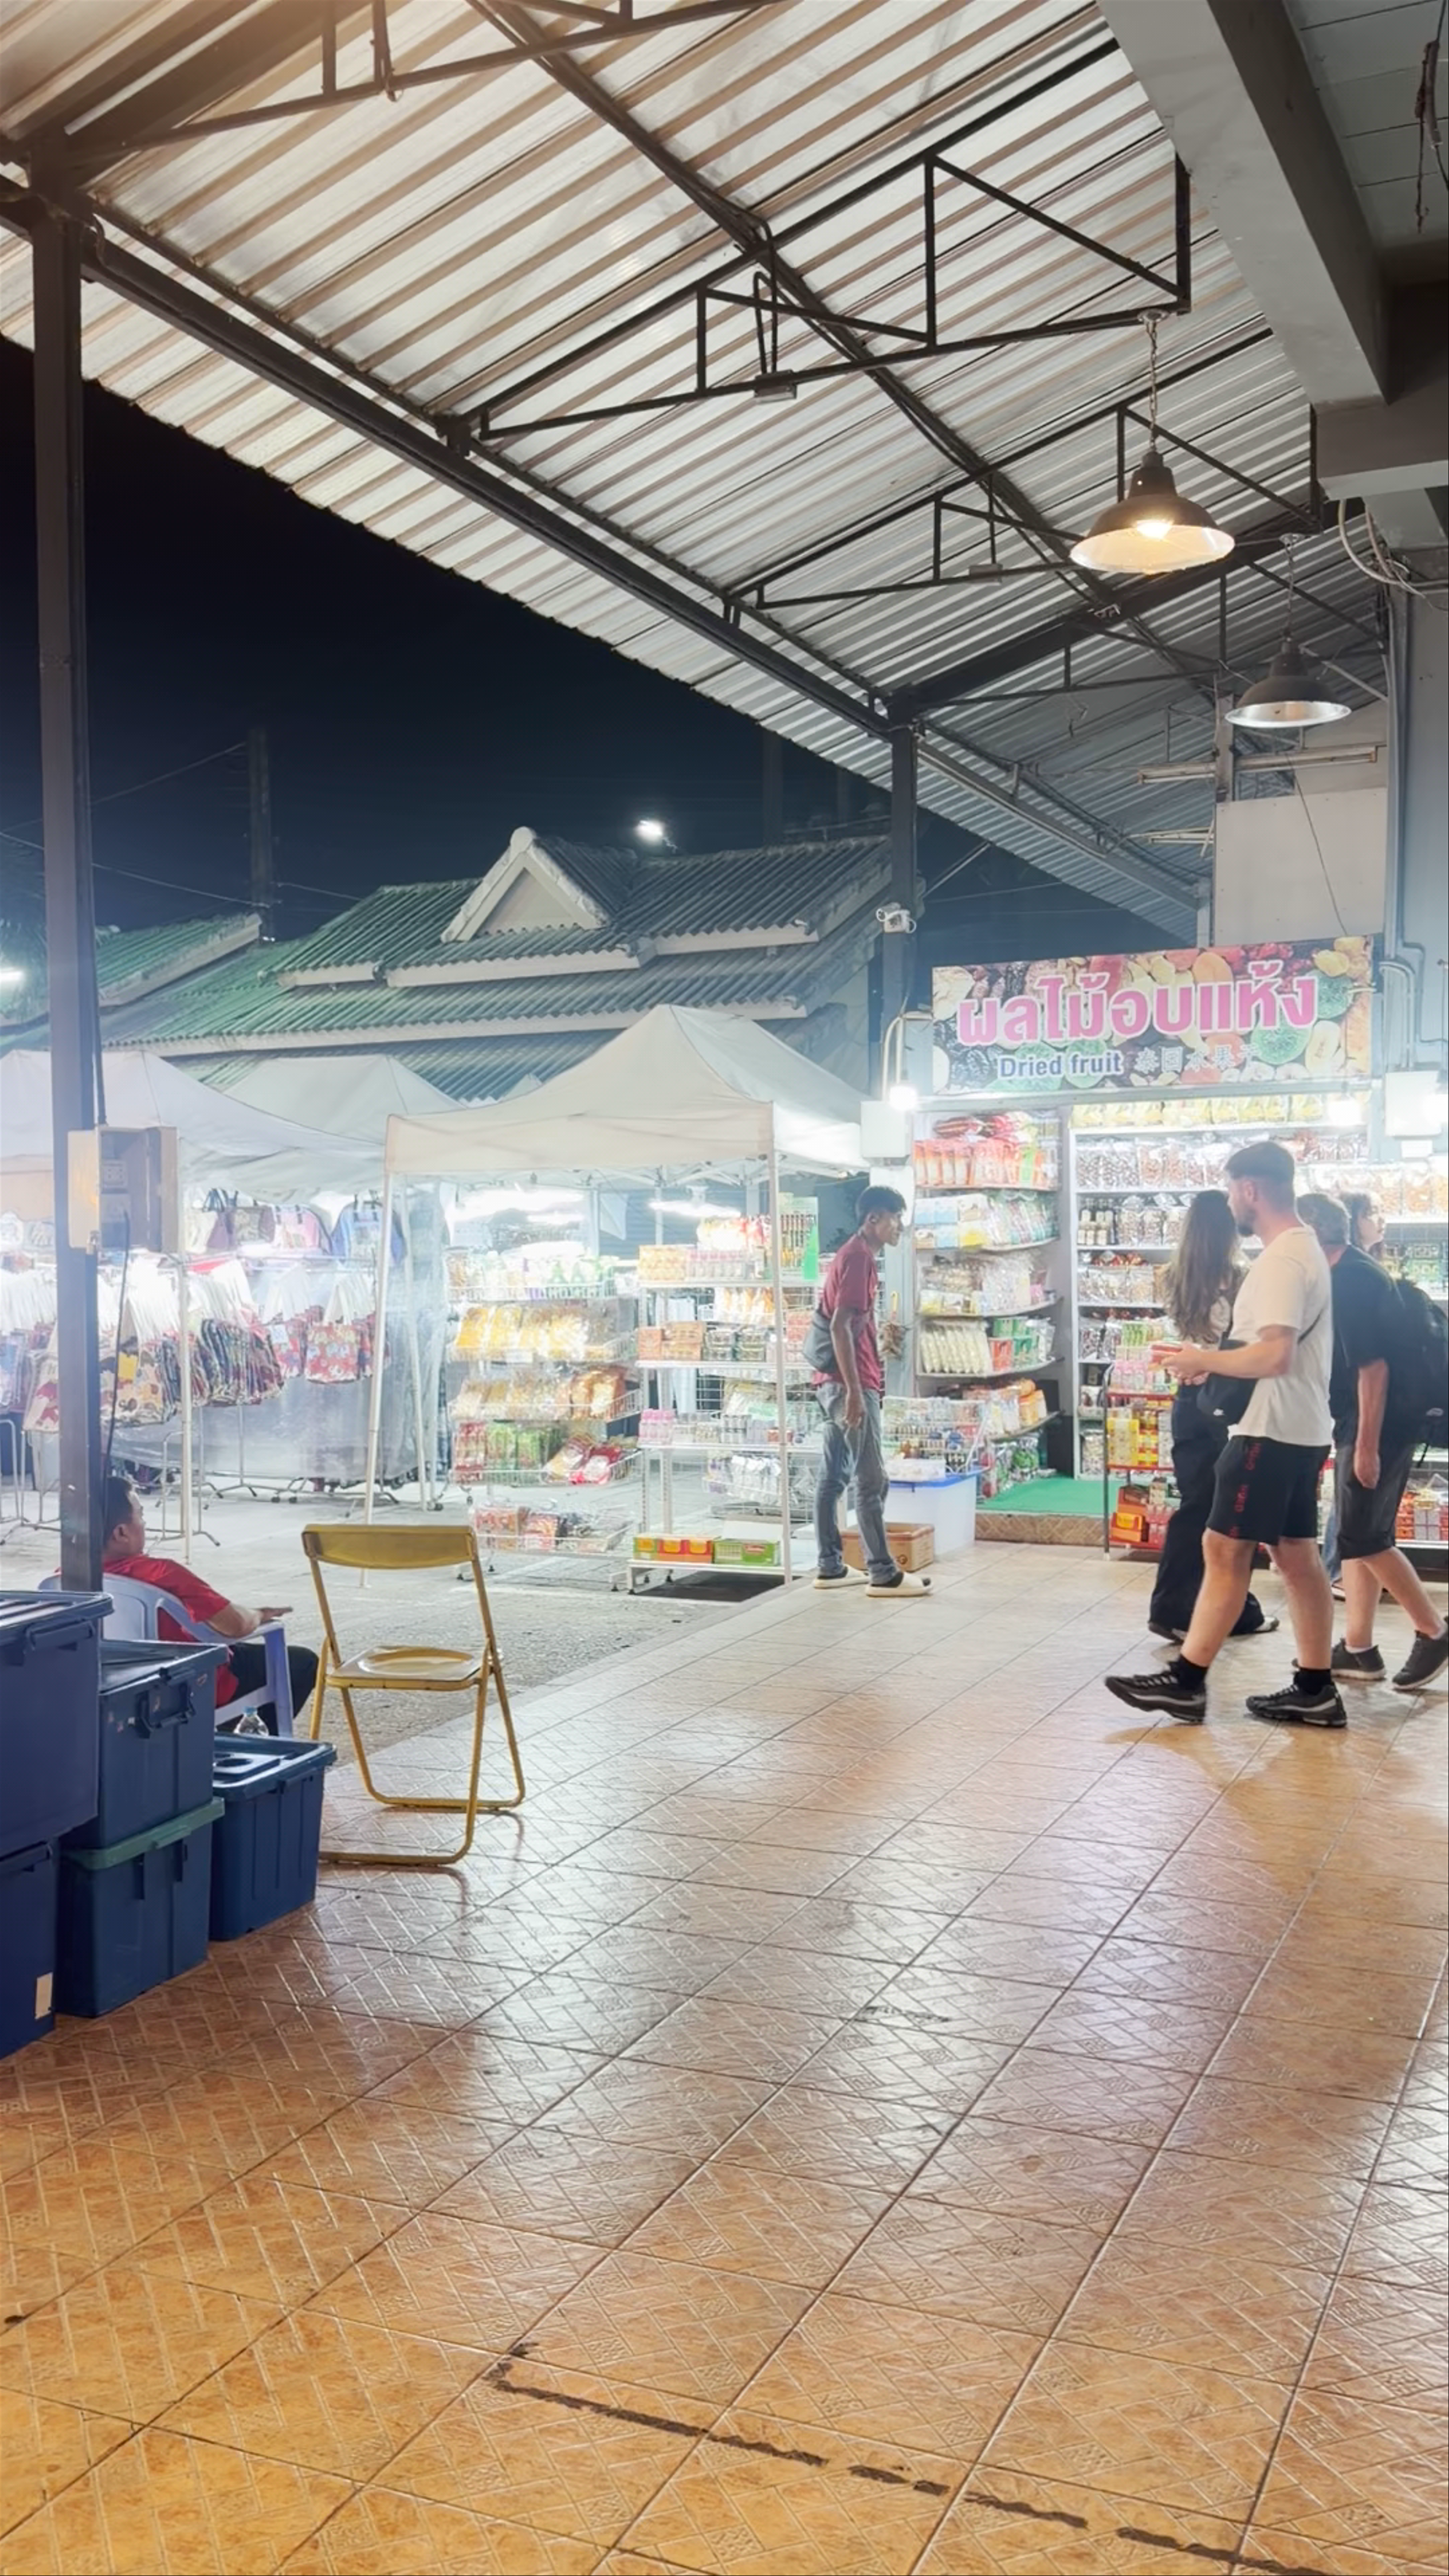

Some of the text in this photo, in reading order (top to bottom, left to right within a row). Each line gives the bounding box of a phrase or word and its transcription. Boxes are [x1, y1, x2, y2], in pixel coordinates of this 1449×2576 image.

[958, 962, 1317, 1044] ผลไม้อบแห้ง
[1000, 1051, 1121, 1077] Dried fruit
